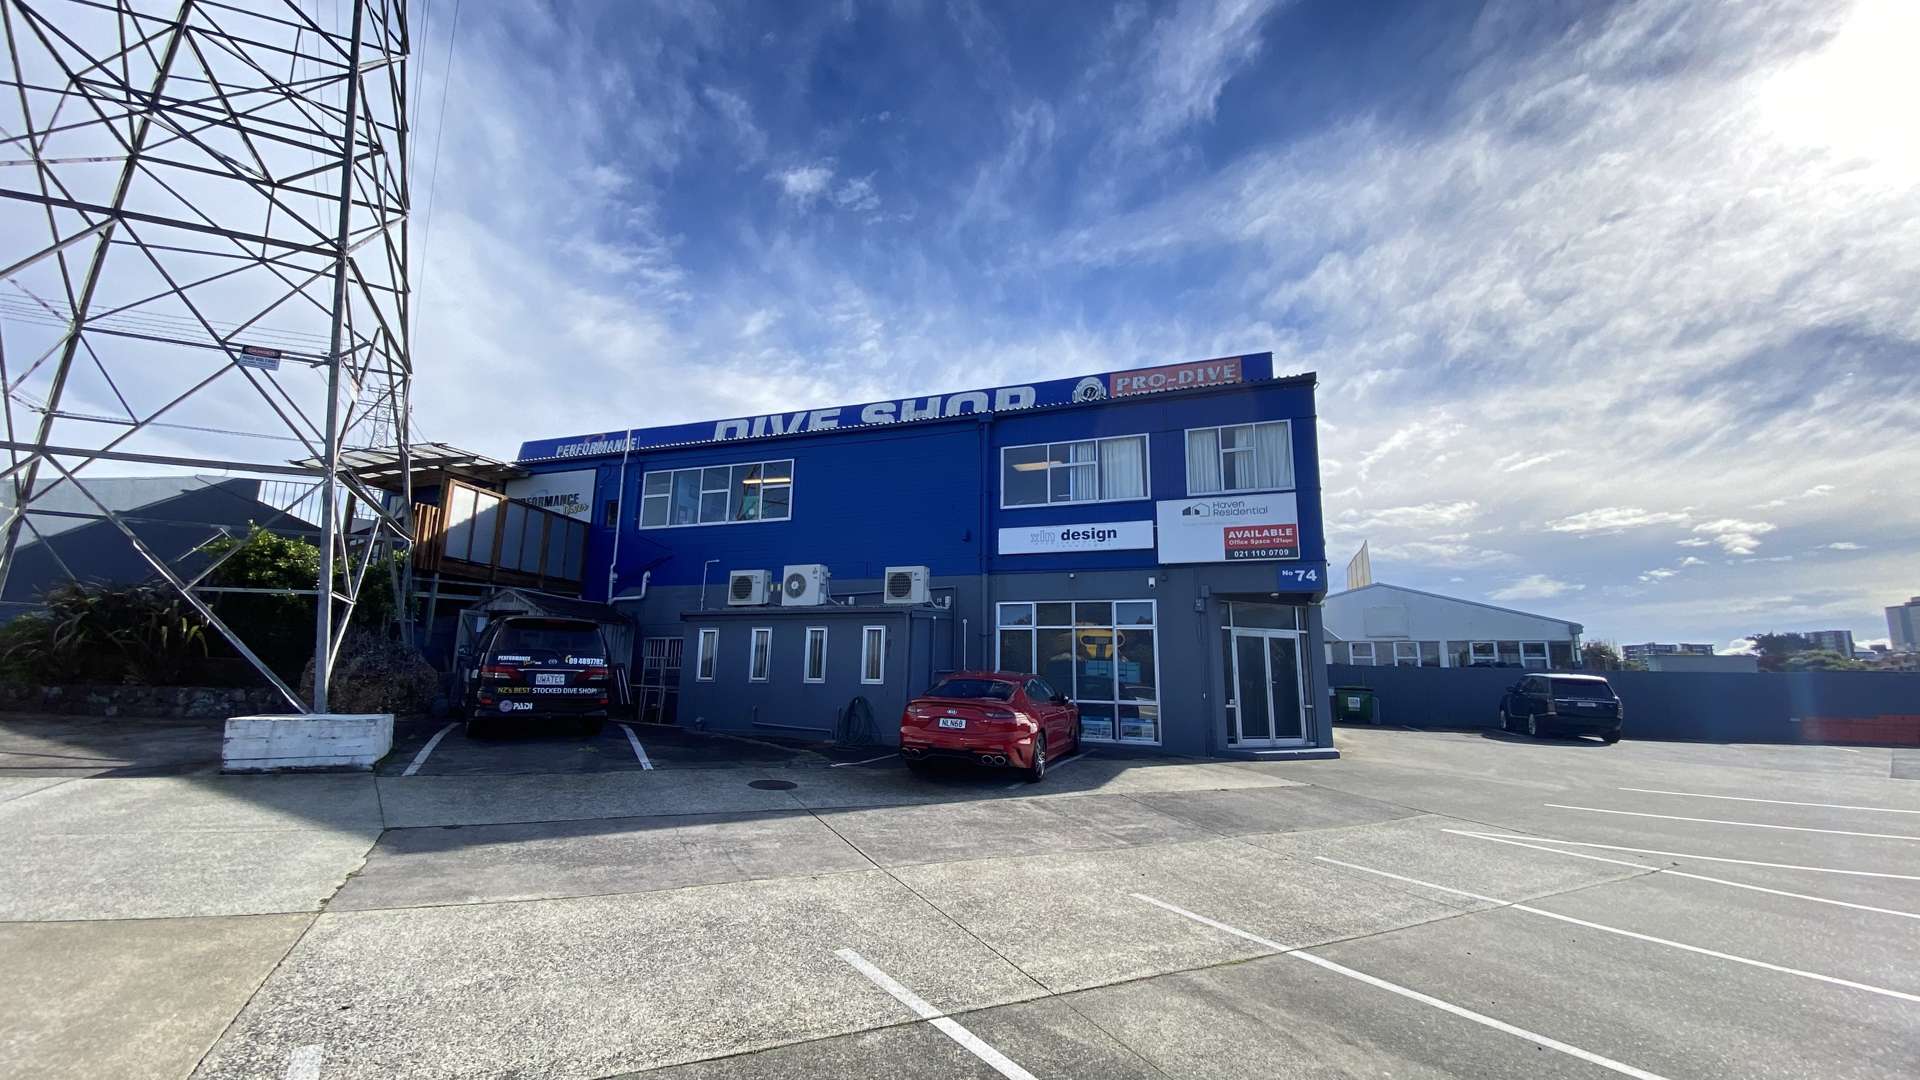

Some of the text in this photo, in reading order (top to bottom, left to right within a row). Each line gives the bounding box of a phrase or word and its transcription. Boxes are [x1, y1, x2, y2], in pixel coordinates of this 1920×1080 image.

[1116, 364, 1236, 391] PRO-DIVE
[713, 386, 1036, 440] DIVE SHOP
[1213, 501, 1245, 509] Haven
[1213, 506, 1268, 517] Residential
[1061, 528, 1117, 542] design
[1228, 528, 1293, 538] AVAILABLE
[1295, 569, 1318, 582] 74
[513, 702, 533, 710] PADI
